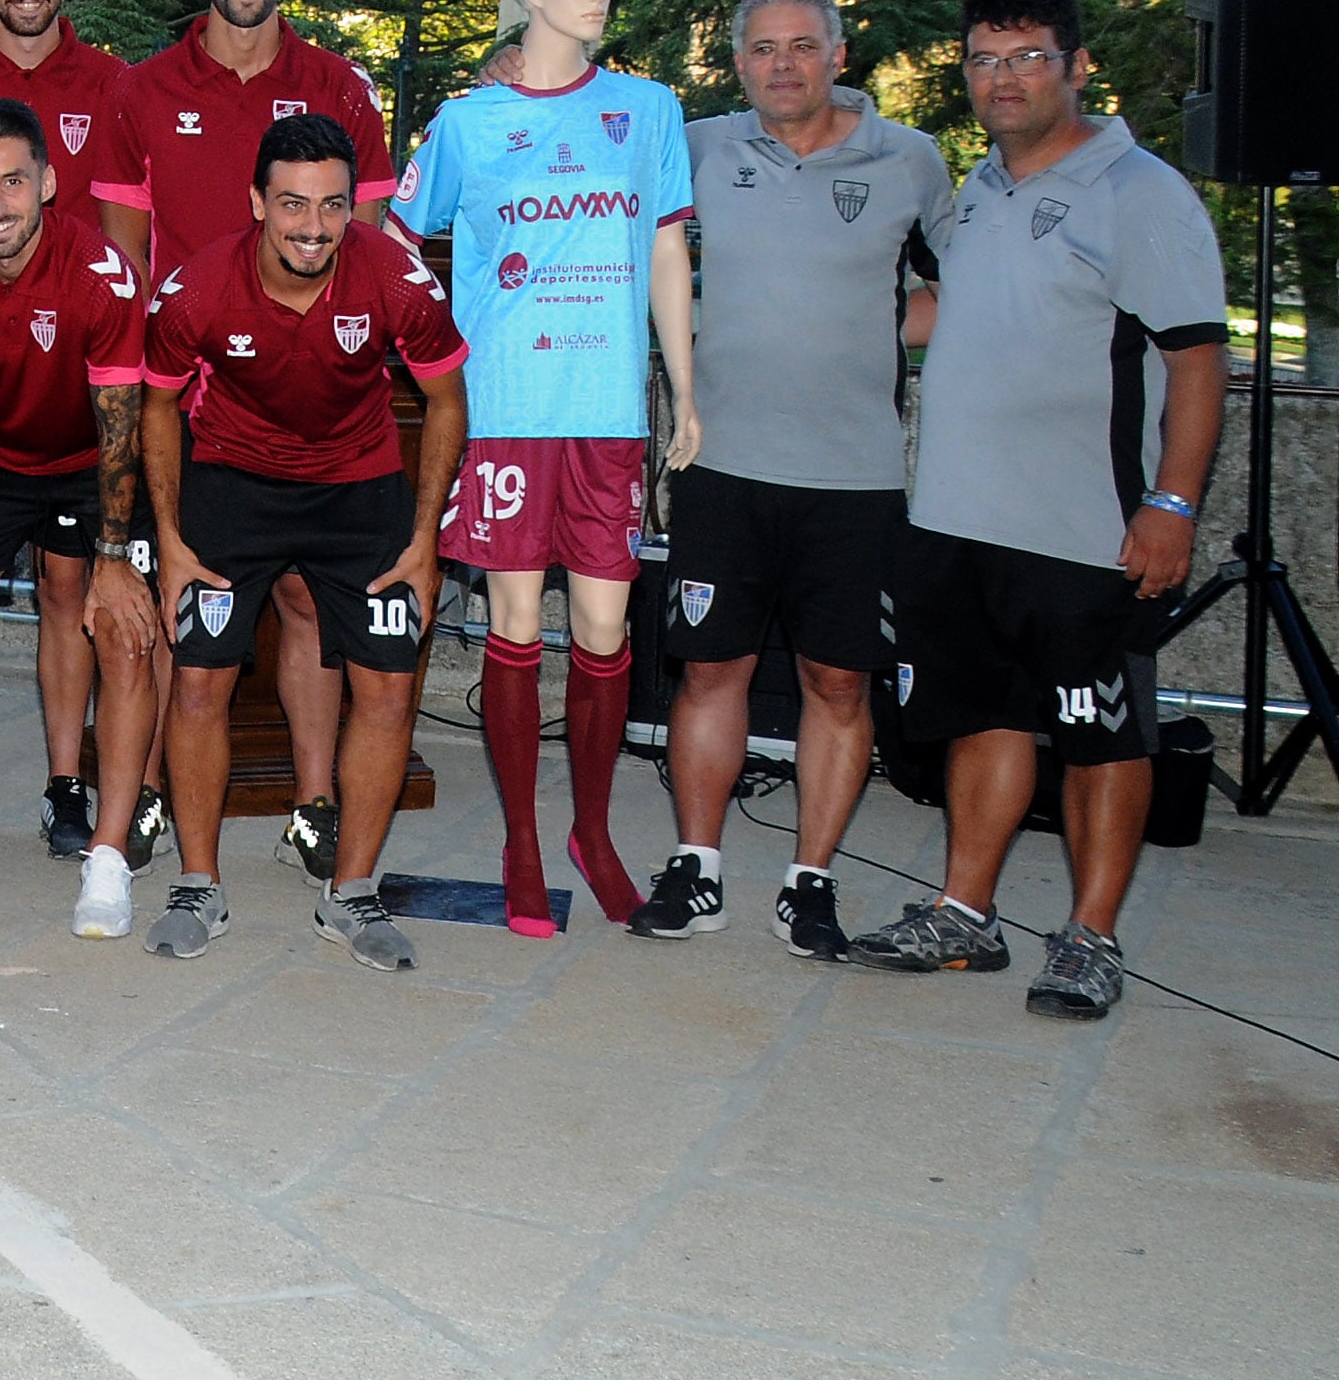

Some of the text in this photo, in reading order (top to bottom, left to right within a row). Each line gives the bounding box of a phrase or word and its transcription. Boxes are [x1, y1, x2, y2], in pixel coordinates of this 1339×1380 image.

[547, 164, 586, 174] SEGOVIA
[536, 294, 605, 305] www.imdsg.es
[554, 332, 608, 345] ALCÁZAR
[476, 460, 527, 520] 19
[366, 598, 408, 636] 10
[1056, 685, 1097, 724] 14
